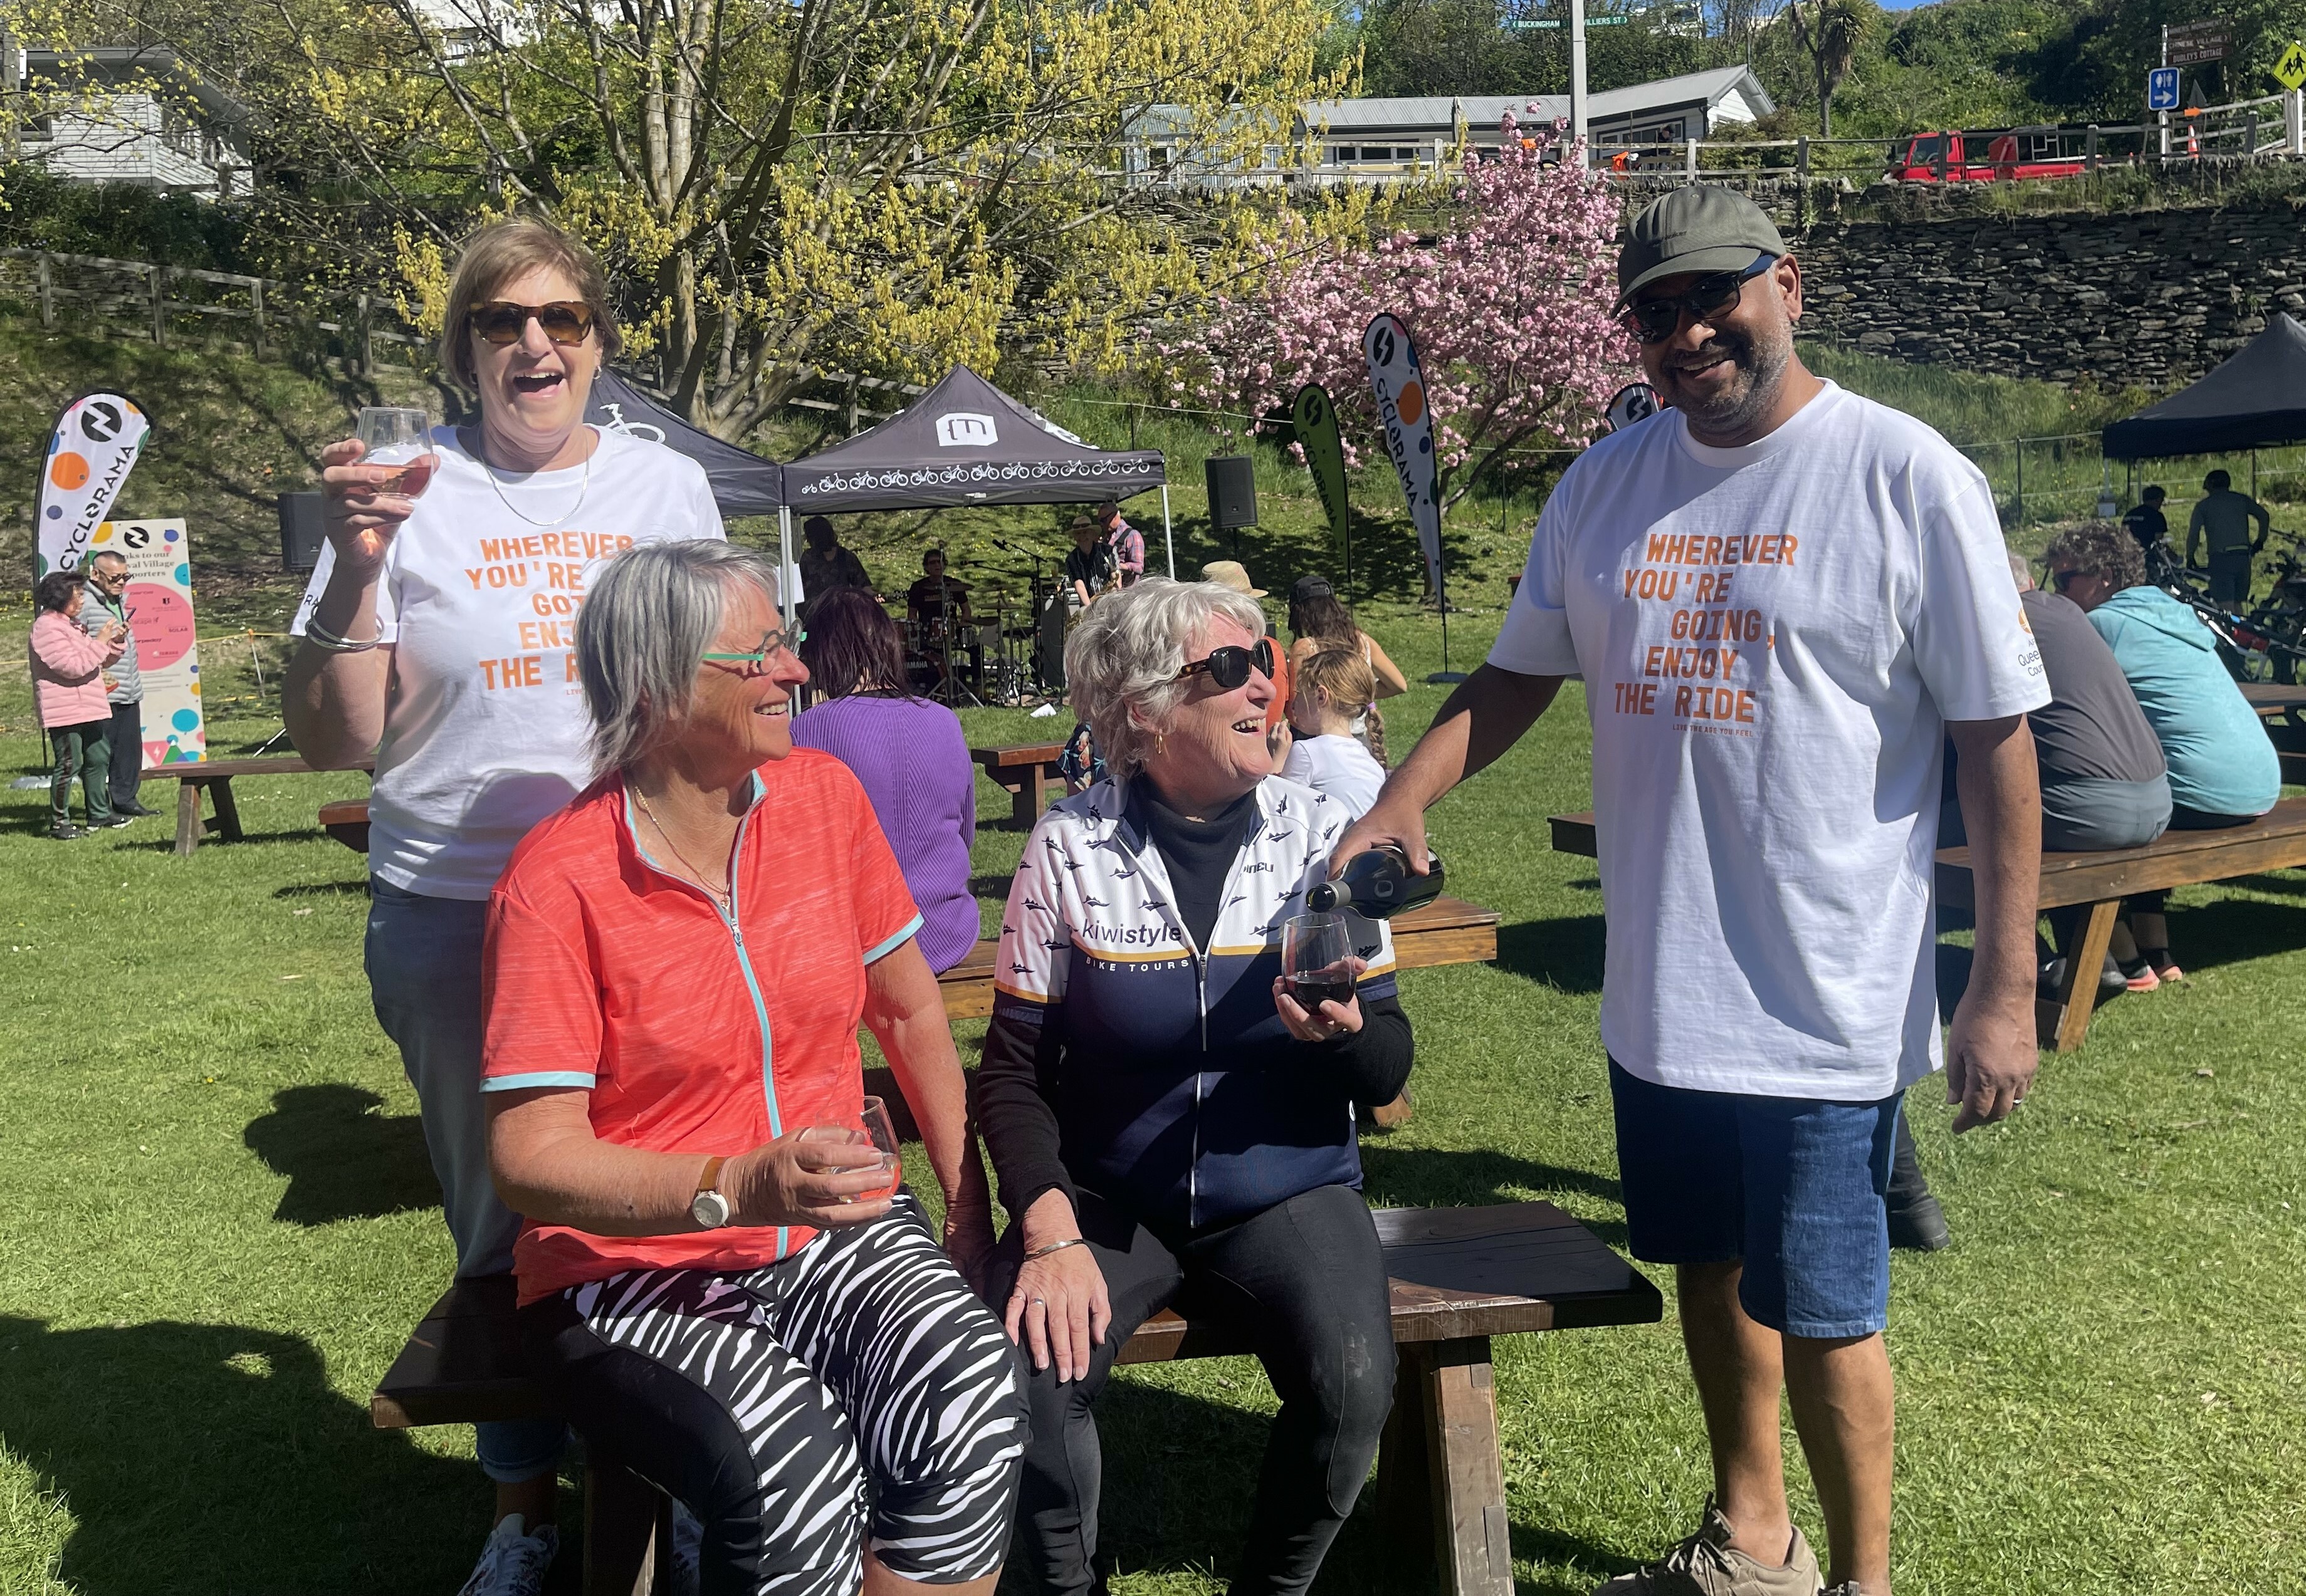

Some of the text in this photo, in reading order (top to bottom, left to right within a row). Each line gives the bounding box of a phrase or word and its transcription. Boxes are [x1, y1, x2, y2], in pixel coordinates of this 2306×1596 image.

[2196, 35, 2222, 44] VILLAGE
[2199, 48, 2223, 59] COTTAGE
[1376, 378, 1418, 506] CYCLORAMA
[60, 447, 135, 570] CYCLORAMA
[143, 560, 174, 568] Village
[1646, 534, 1798, 566] WHEREVER
[464, 561, 585, 590] YOU'RE
[1624, 568, 1733, 603] YOU'RE
[479, 655, 543, 691] THE
[1645, 646, 1739, 681] ENJOY
[1615, 682, 1755, 723] THE RIDE
[1082, 919, 1182, 947] kiwistyle
[1086, 956, 1189, 972] BIKE TOURS
